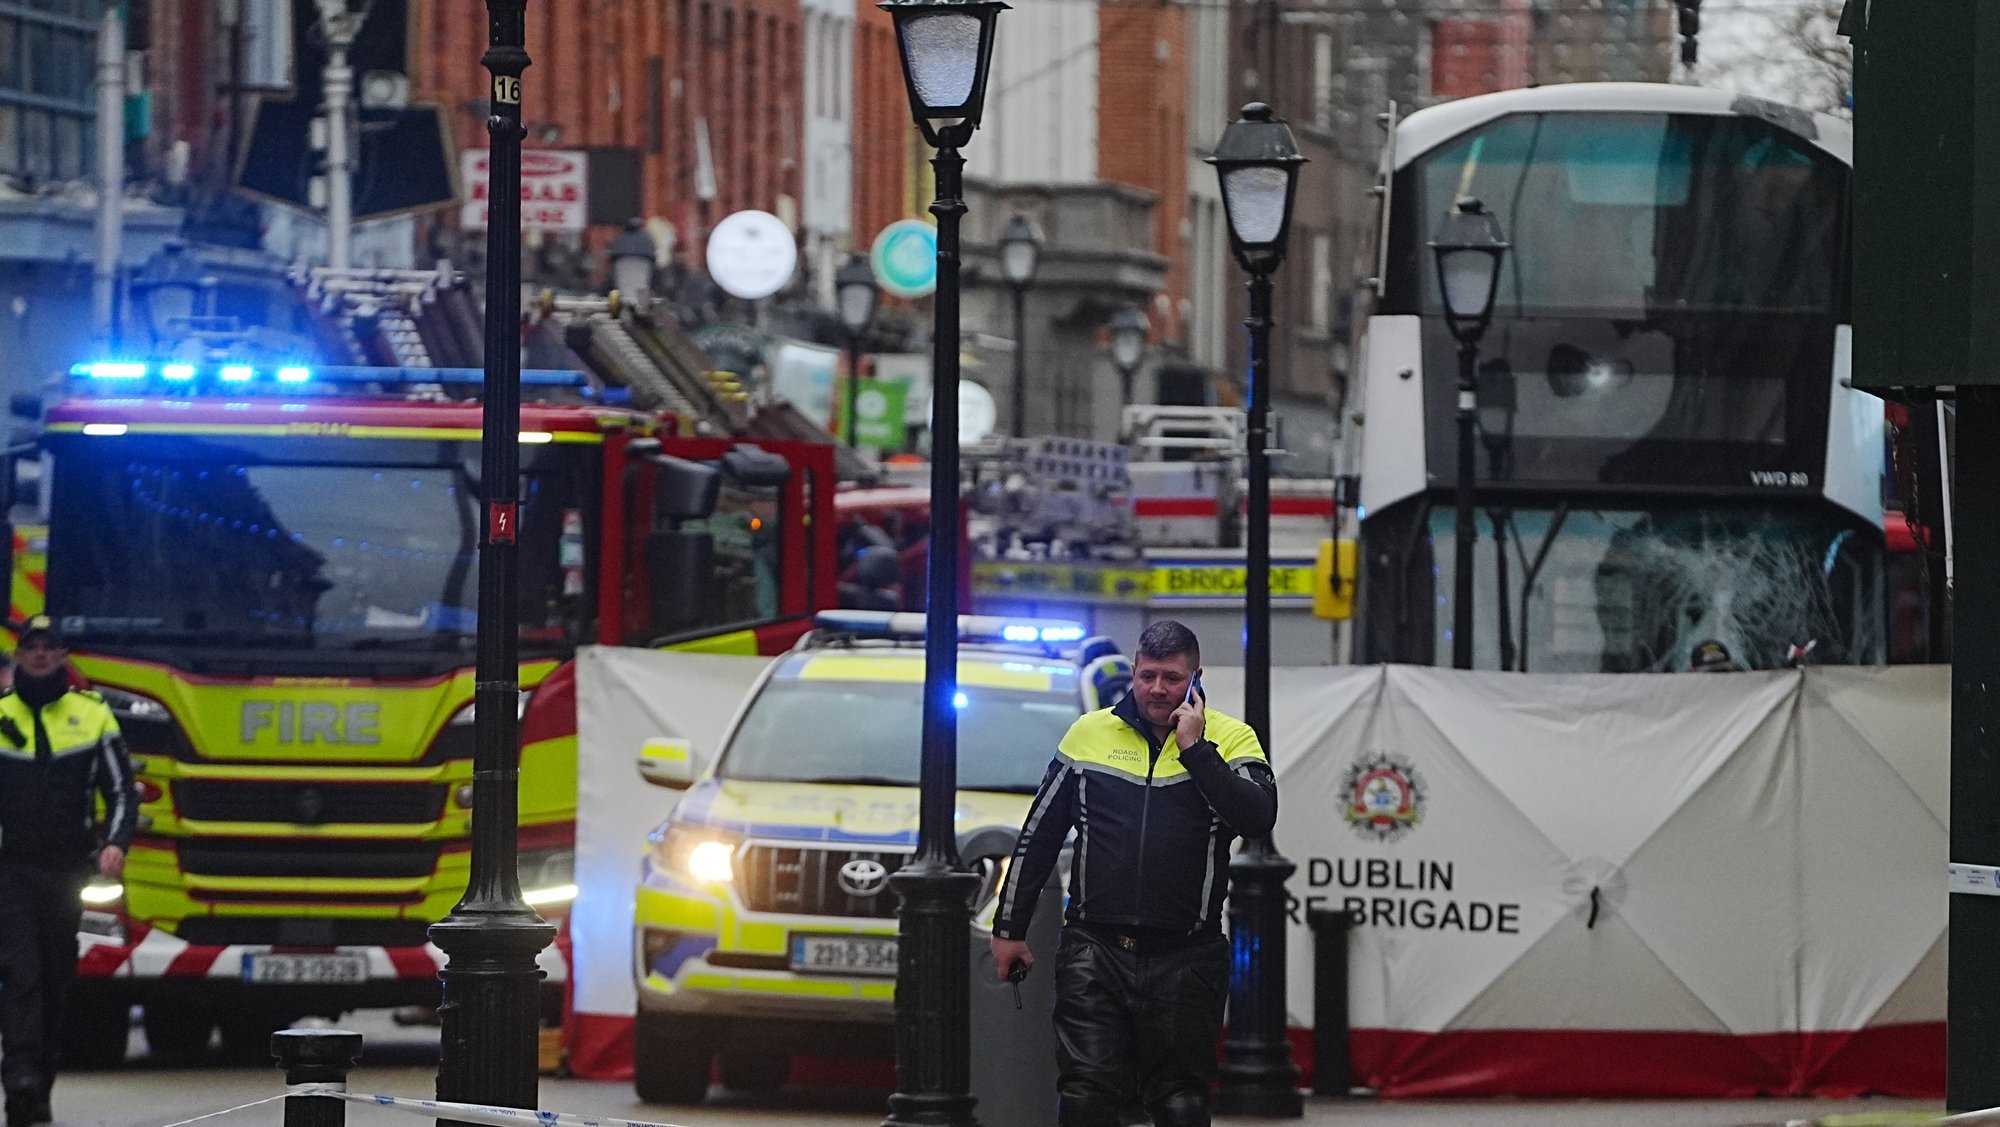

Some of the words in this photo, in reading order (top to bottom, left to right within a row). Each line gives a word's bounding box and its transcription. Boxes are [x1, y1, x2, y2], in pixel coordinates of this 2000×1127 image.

[498, 77, 520, 101] 16
[1750, 470, 1787, 487] VWD
[1789, 471, 1809, 488] 80
[240, 701, 380, 744] FIRE
[1107, 754, 1143, 762] POLICING
[1112, 748, 1138, 756] ROADS
[1308, 857, 1453, 891] DUBLIN
[1344, 896, 1520, 934] BRIGADE
